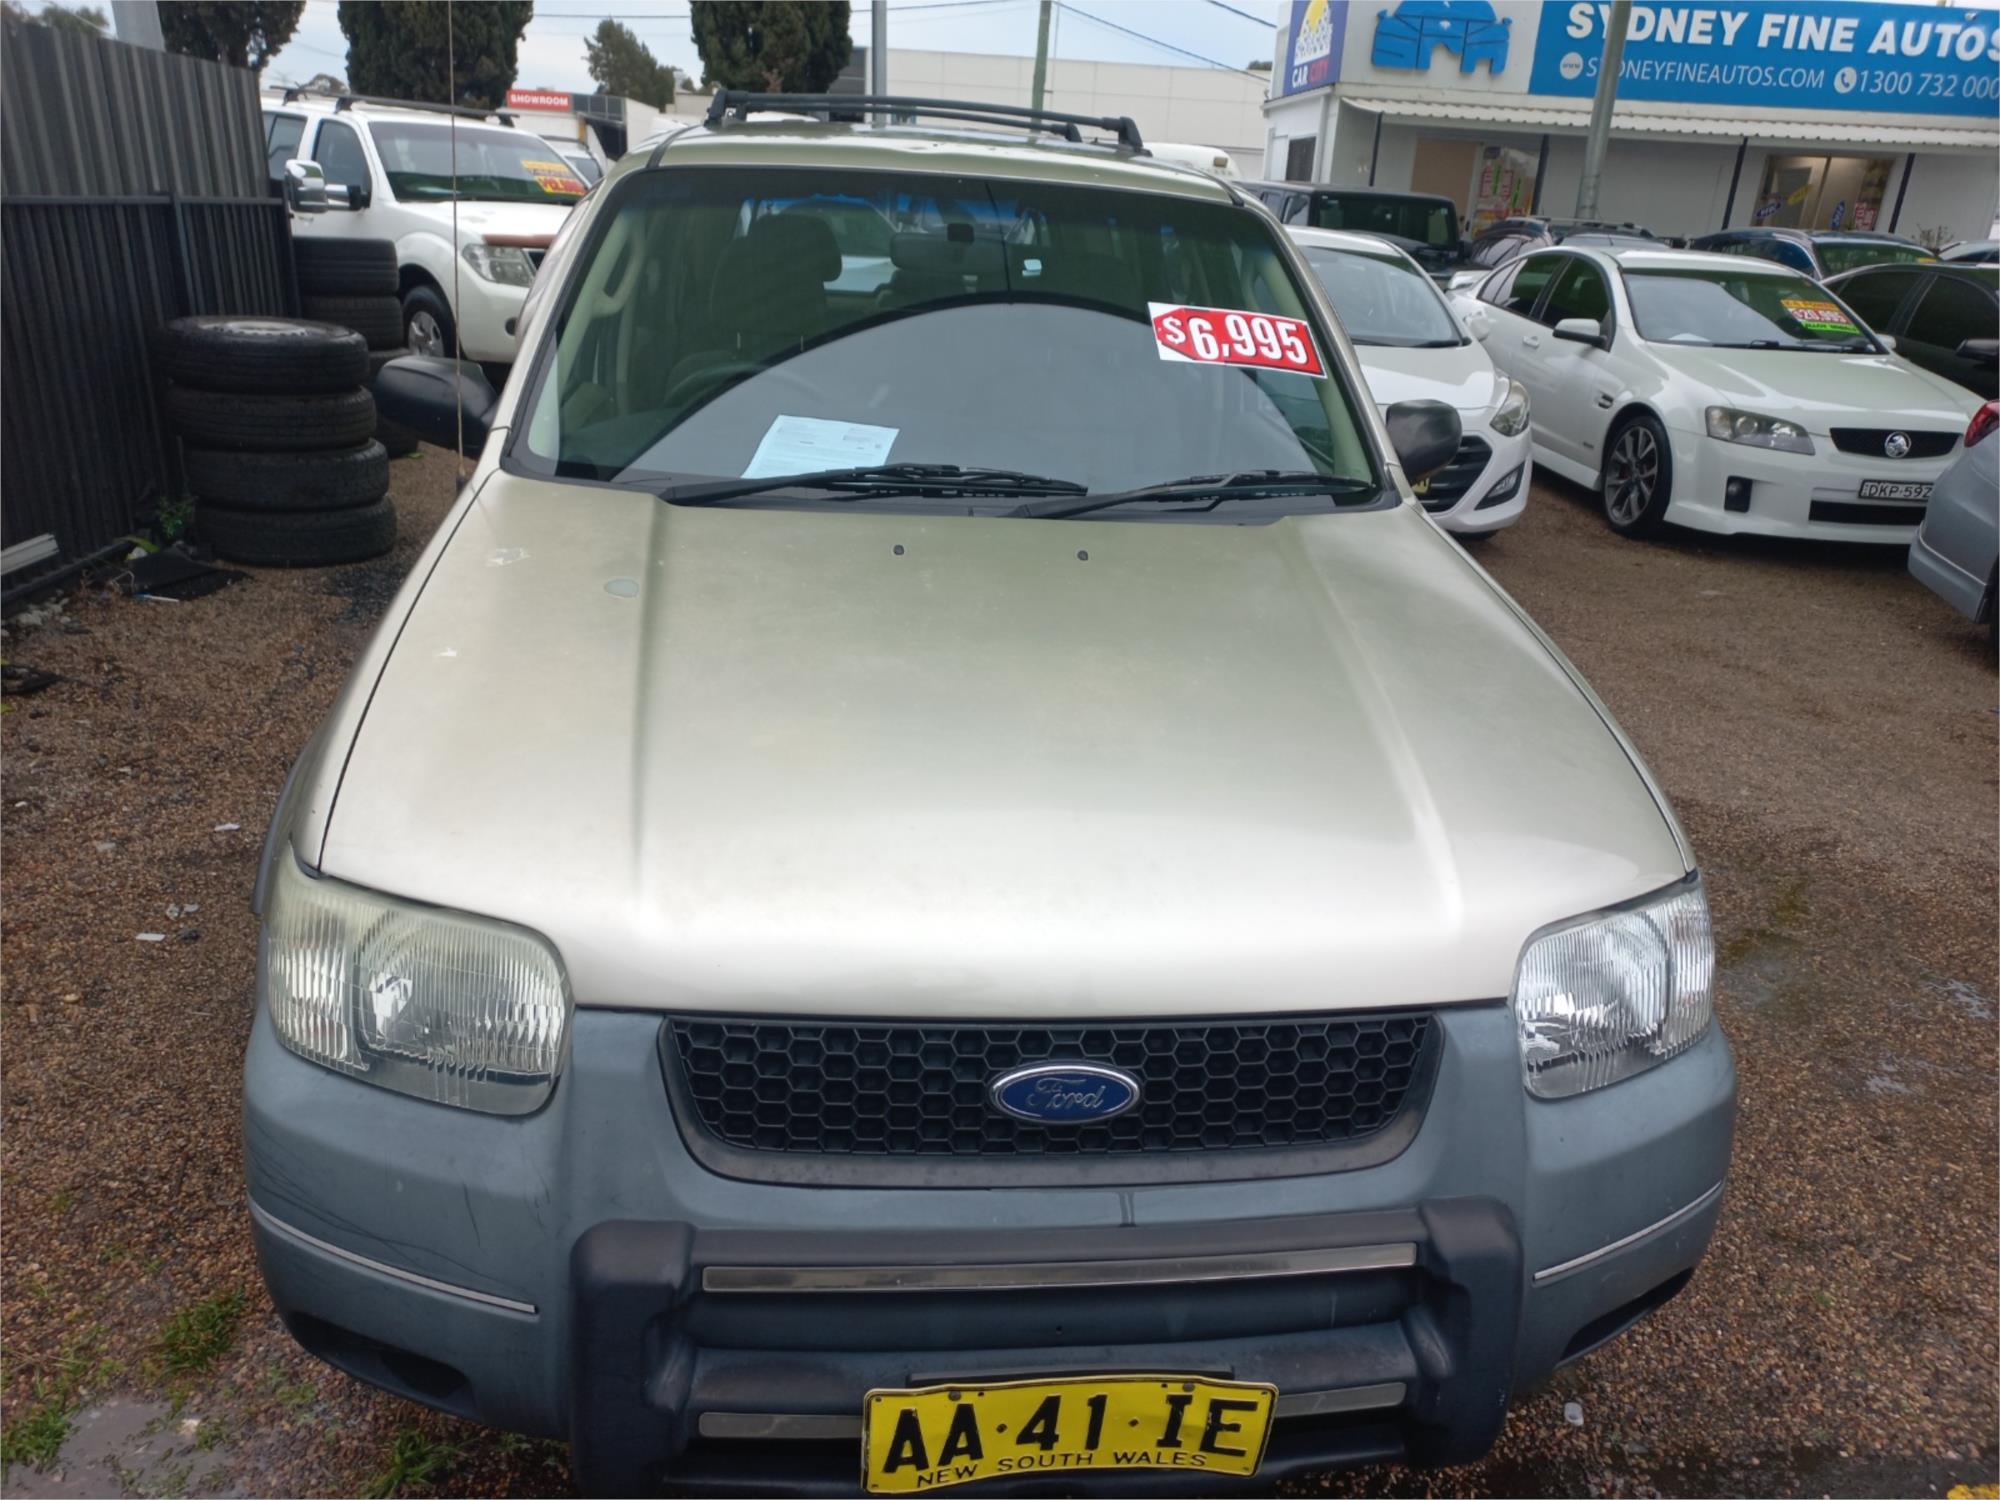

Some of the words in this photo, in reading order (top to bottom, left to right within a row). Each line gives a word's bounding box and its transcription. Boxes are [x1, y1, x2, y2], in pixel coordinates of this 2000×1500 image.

[1757, 13, 1859, 53] FINE
[1292, 65, 1309, 89] CAR
[1586, 56, 1825, 89] SNEYFINEAUTOS.COM
[1860, 70, 1912, 95] 1300
[1916, 73, 1958, 97] 732
[1962, 75, 1999, 99] 000
[510, 93, 569, 107] SHOWROOM
[1162, 314, 1308, 365] $6,995
[1026, 1076, 1107, 1110] Ford
[916, 1464, 978, 1488] NEW
[996, 1451, 1093, 1471] SOUTH
[1113, 1450, 1208, 1468] WALES
